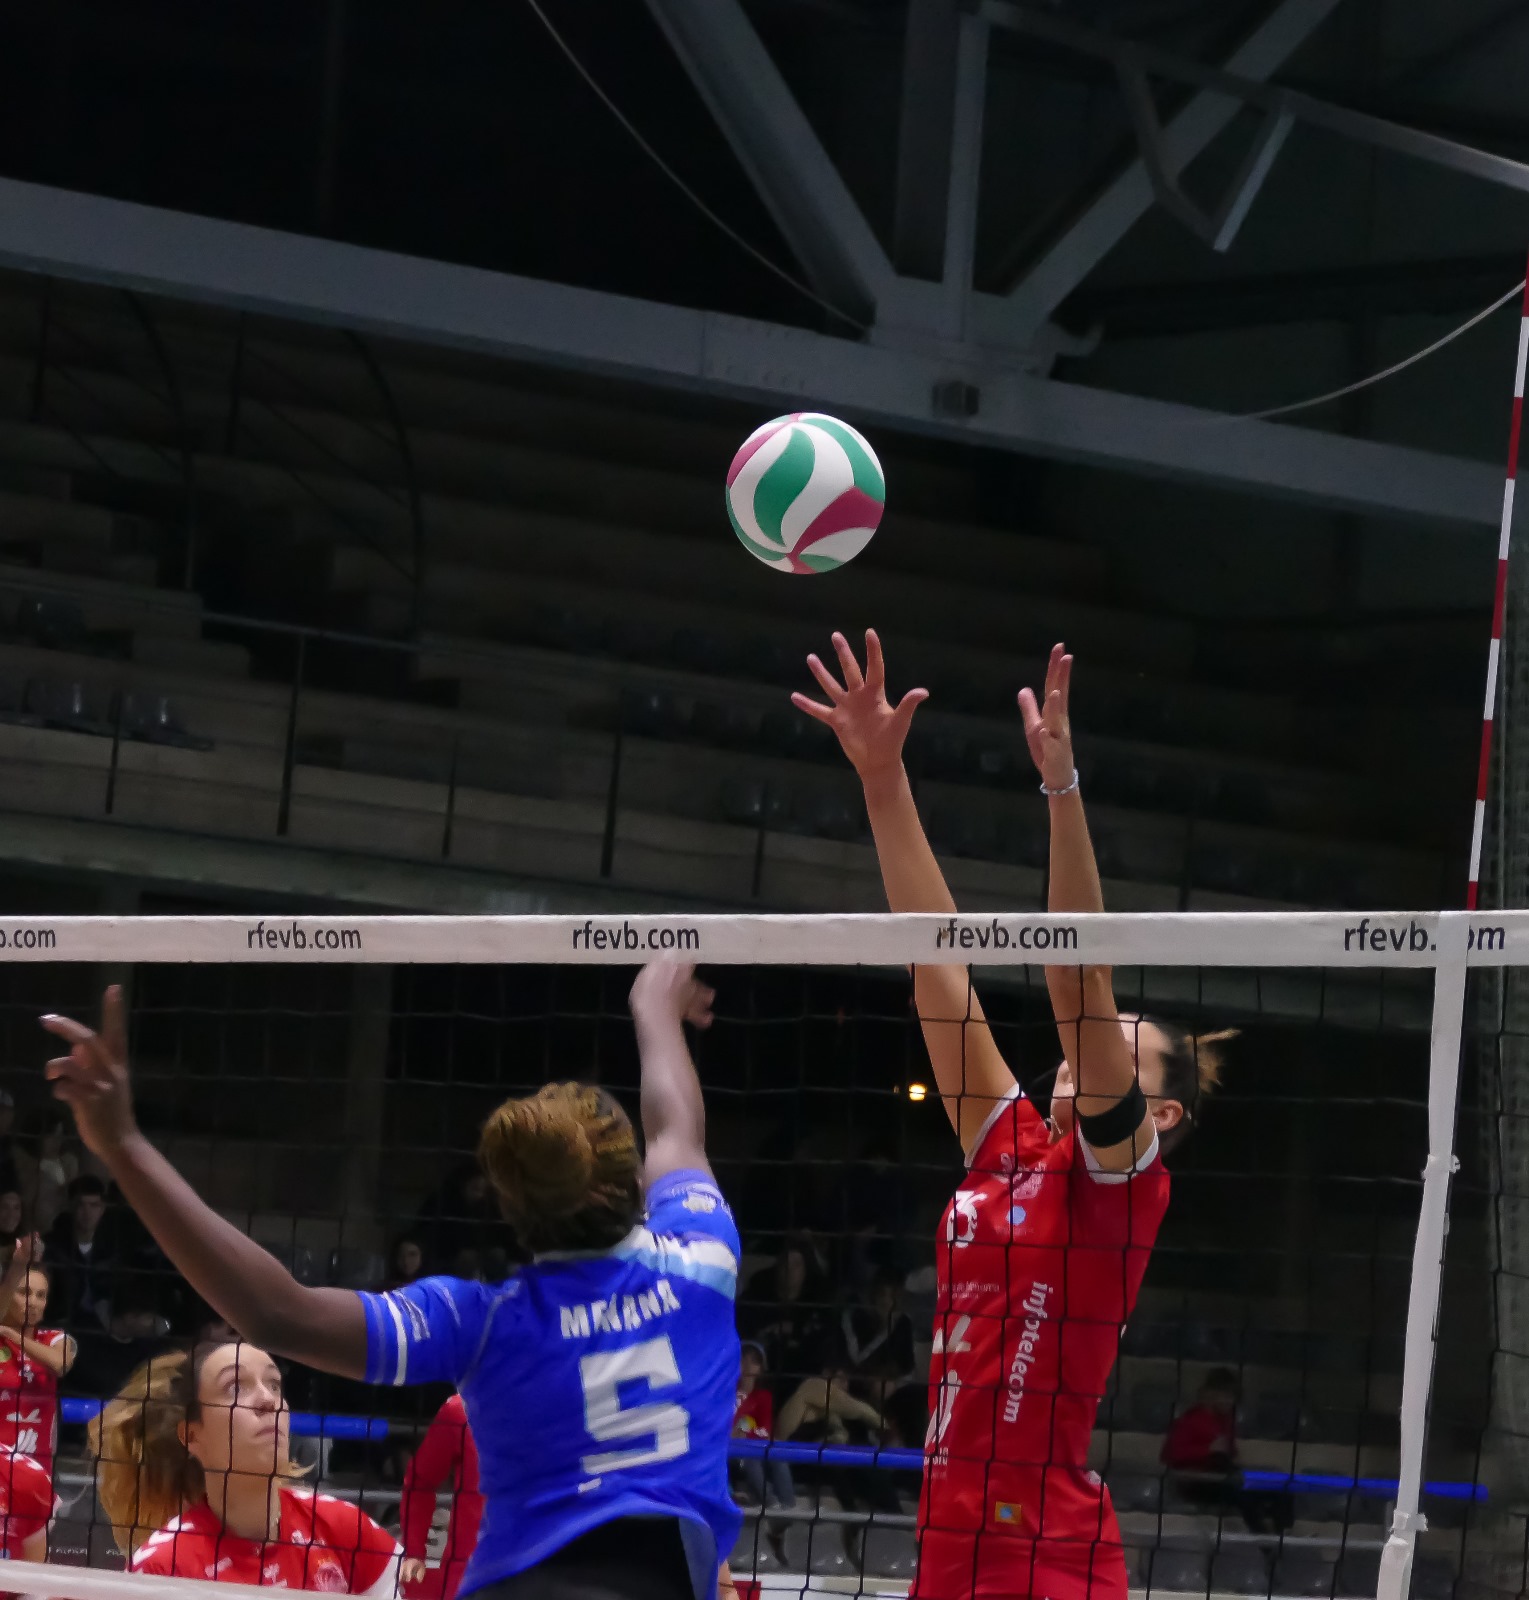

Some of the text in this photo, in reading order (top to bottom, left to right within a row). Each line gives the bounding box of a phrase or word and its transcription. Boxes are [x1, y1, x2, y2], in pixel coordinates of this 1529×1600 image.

[247, 921, 362, 949] rfevb.com
[572, 920, 699, 950] rfevb.com
[937, 918, 1078, 949] rfevb.com
[1344, 918, 1506, 952] rfevb.m
[1003, 1281, 1054, 1424] infotelecom
[579, 1332, 690, 1476] 5
